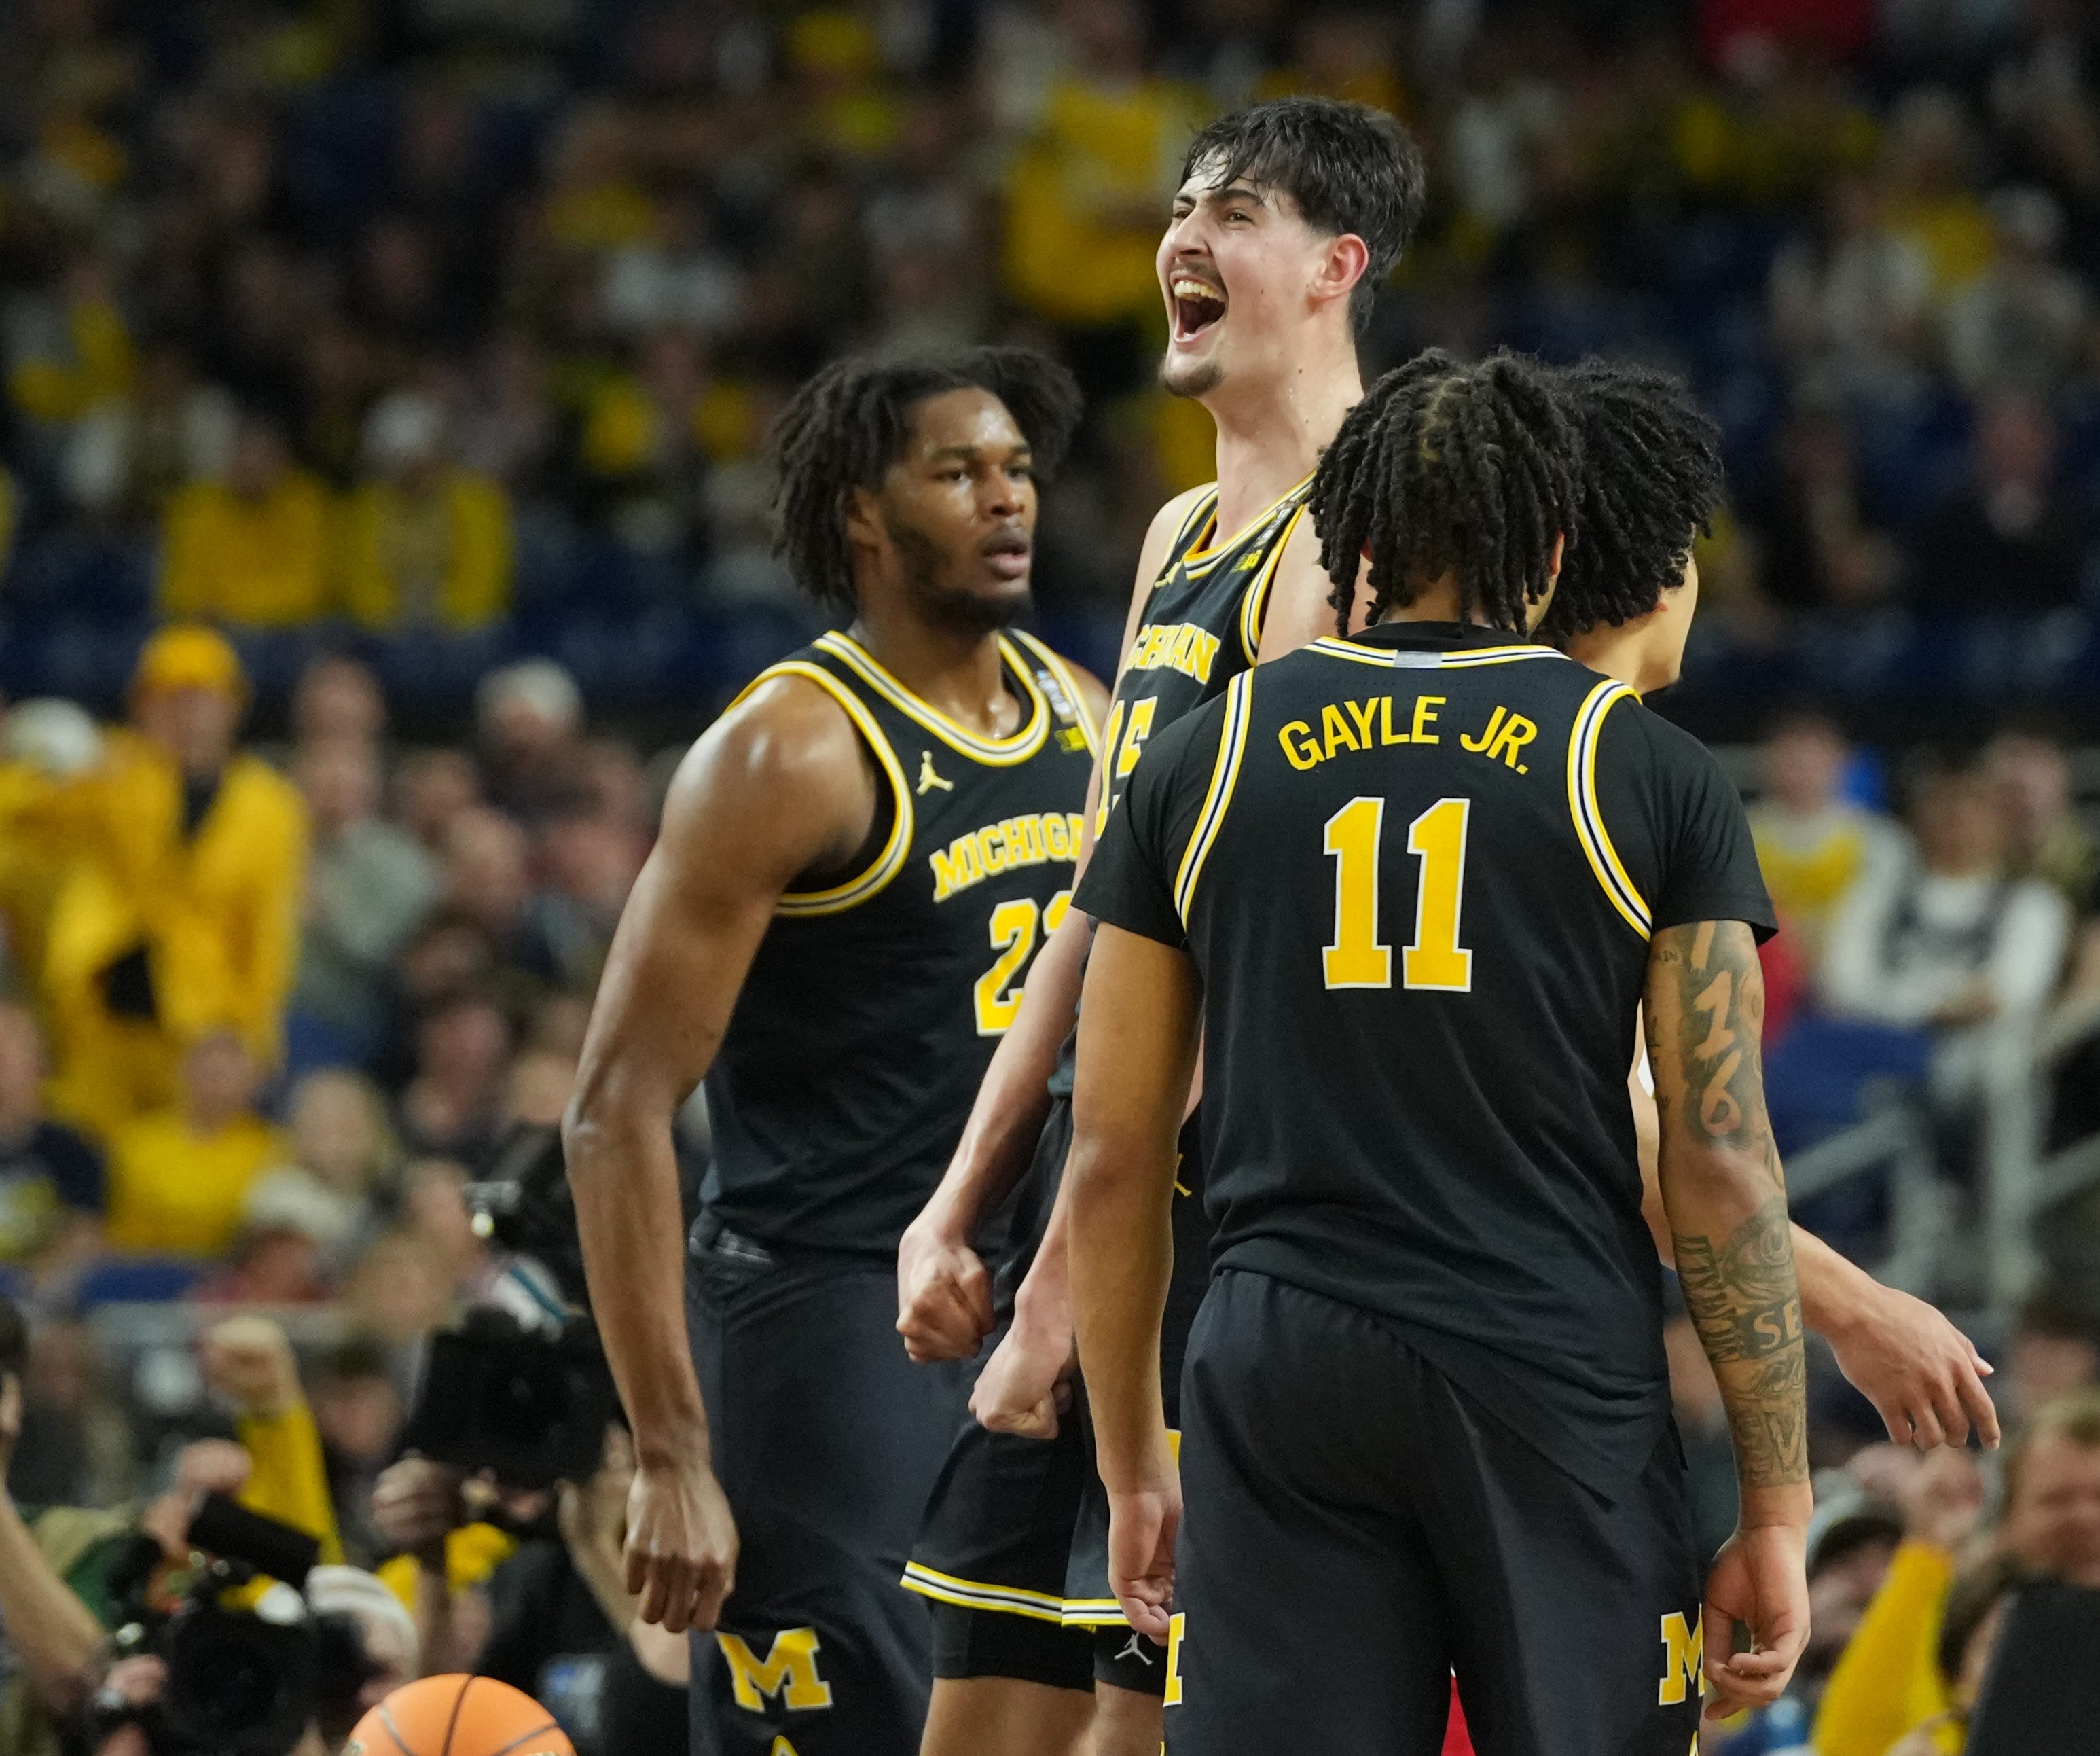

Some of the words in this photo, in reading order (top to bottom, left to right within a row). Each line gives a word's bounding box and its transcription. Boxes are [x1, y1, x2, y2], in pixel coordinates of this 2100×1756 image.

[1278, 696, 1447, 770] GAYLE
[1460, 706, 1538, 776] JR.
[1322, 796, 1473, 992] 11
[973, 889, 1073, 1037] 2
[714, 1626, 833, 1714] M
